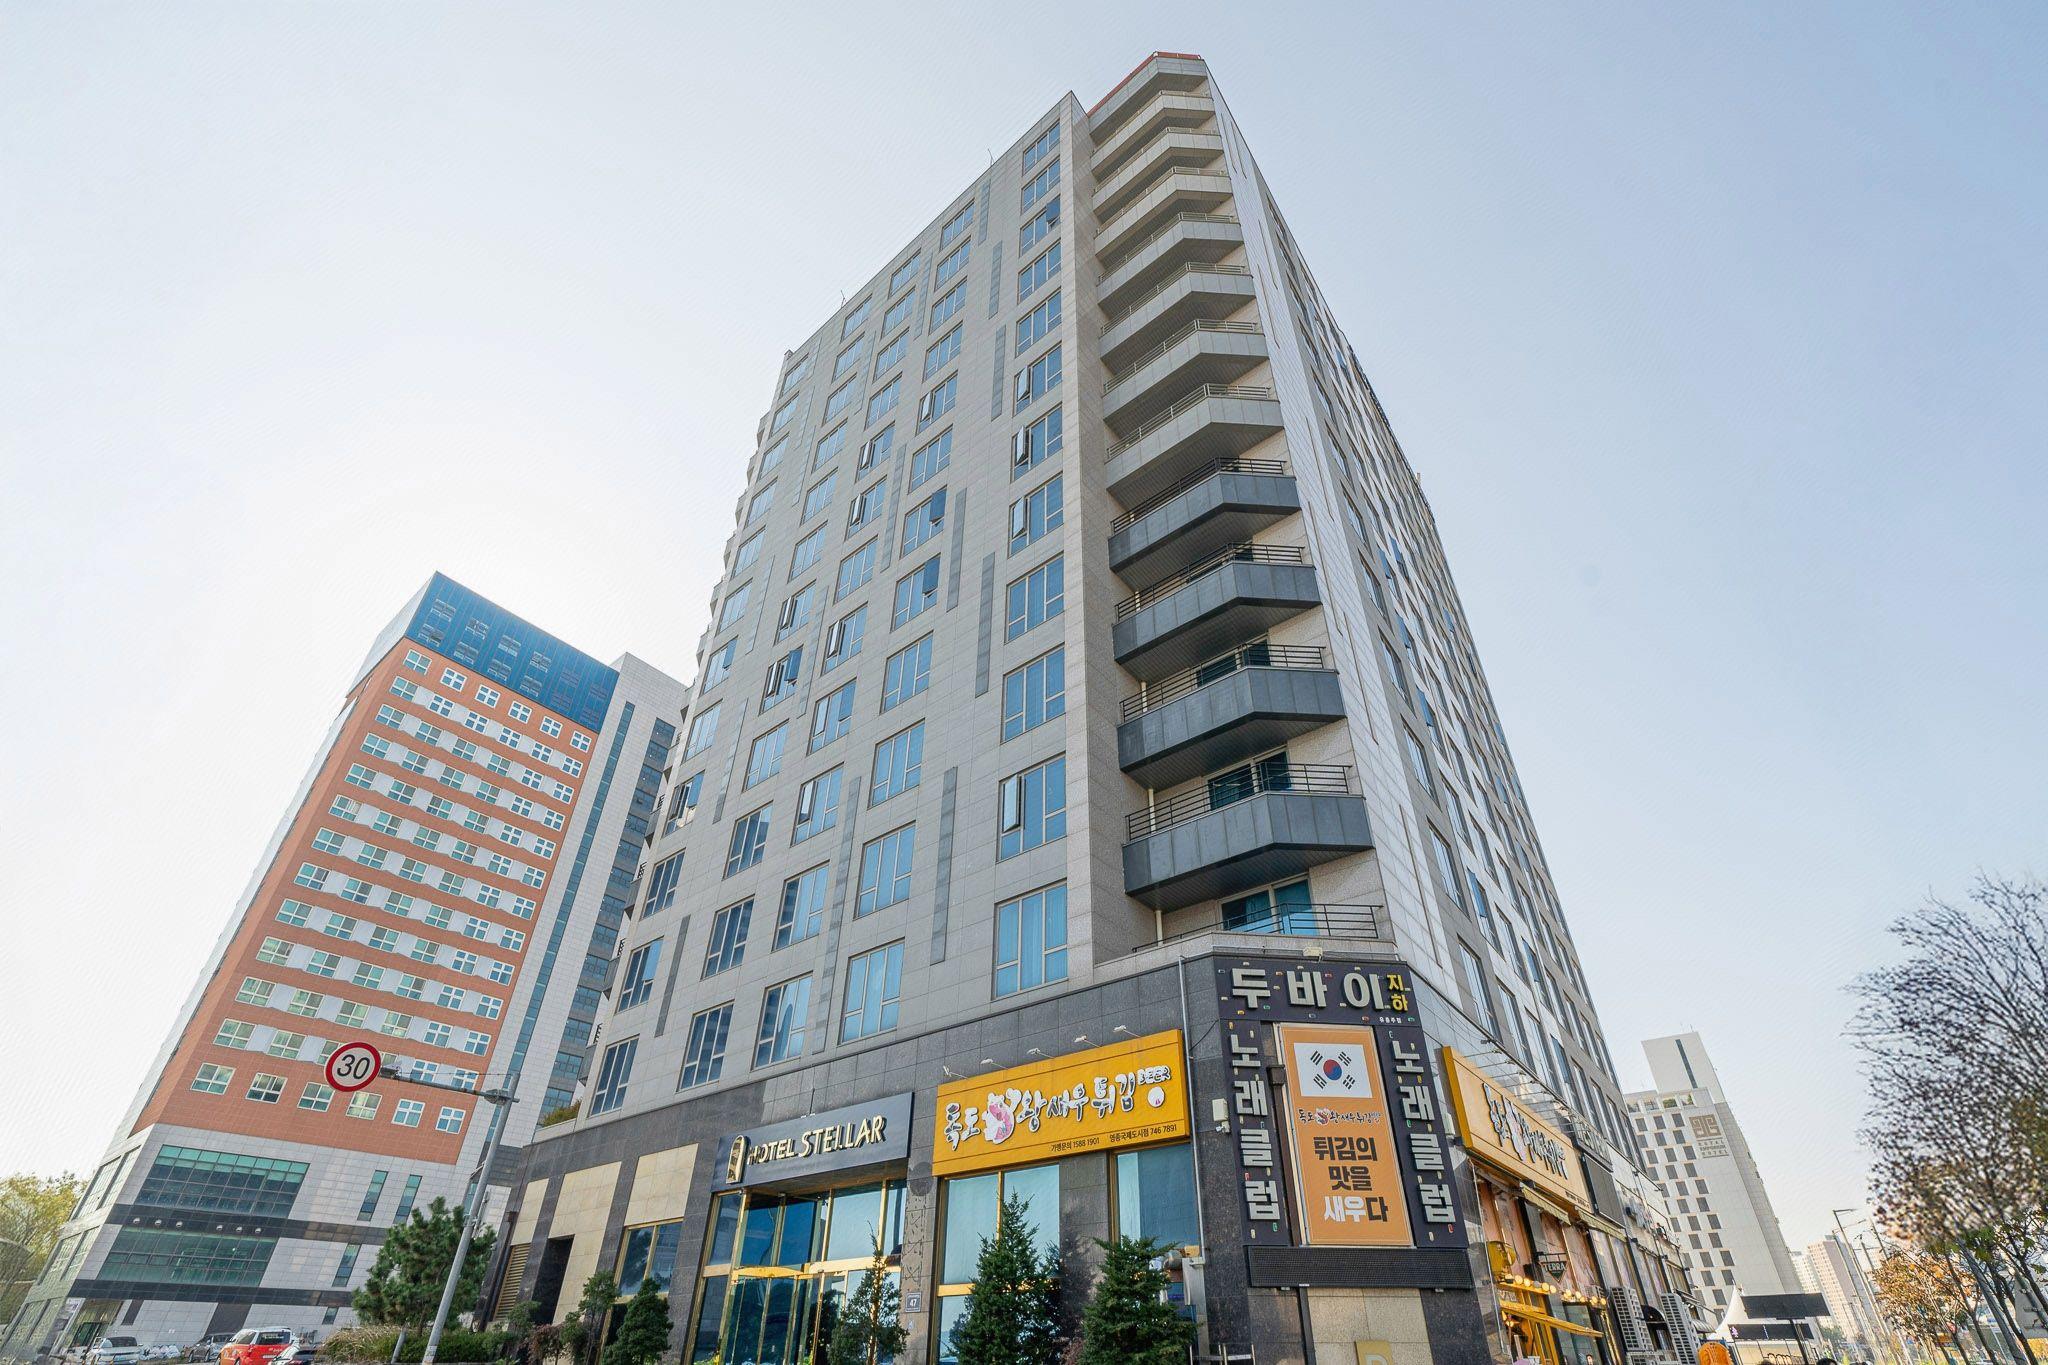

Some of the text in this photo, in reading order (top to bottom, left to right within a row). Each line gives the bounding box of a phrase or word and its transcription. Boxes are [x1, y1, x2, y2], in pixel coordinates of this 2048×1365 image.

[1231, 969, 1384, 1011] 두바이
[1387, 974, 1409, 1012] 지하
[336, 1054, 371, 1080] 30
[944, 1102, 980, 1151] 독도
[1137, 1065, 1171, 1086] BEER
[746, 1115, 887, 1165] HOTEL STELLAR
[1150, 1126, 1162, 1136] 746
[1162, 1123, 1178, 1133] 7891
[1313, 1136, 1378, 1162] 튀김의
[1328, 1166, 1373, 1191] 맛을
[1324, 1195, 1389, 1223] 새우다
[1543, 1261, 1567, 1272] TERRA
[909, 1298, 917, 1307] 47
